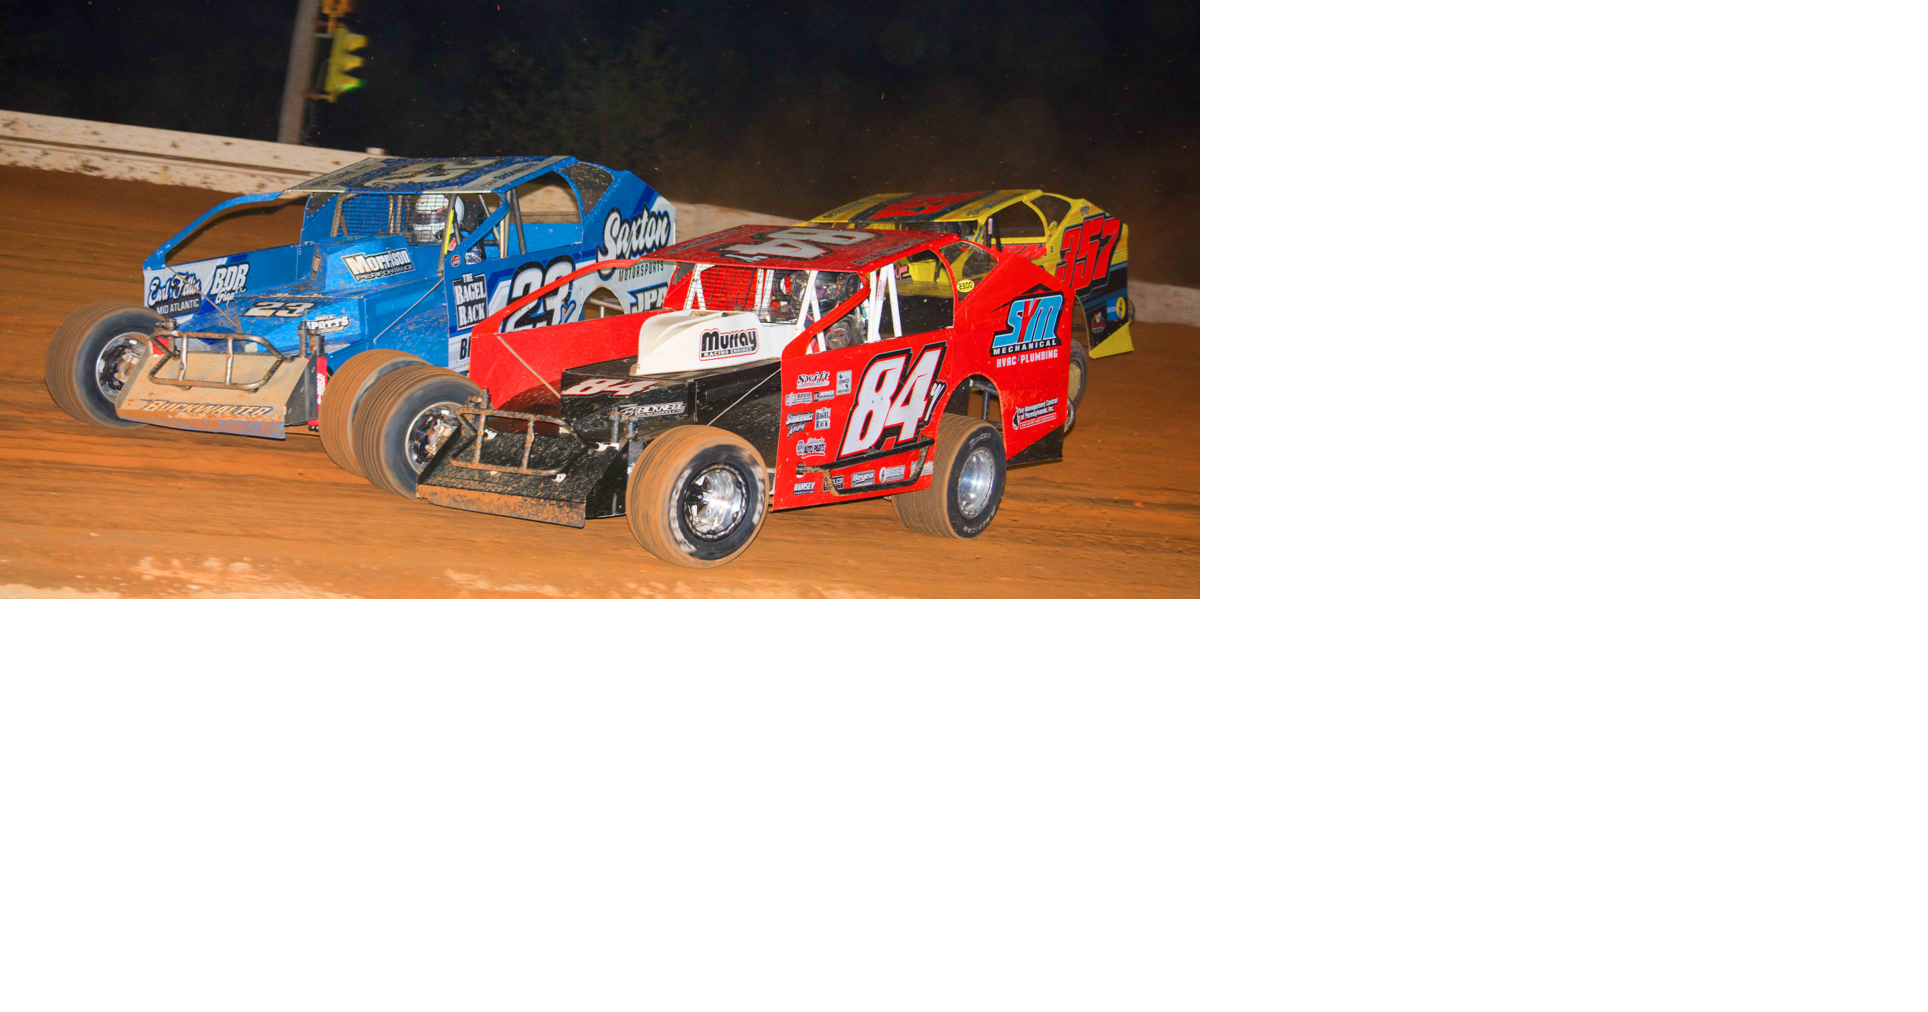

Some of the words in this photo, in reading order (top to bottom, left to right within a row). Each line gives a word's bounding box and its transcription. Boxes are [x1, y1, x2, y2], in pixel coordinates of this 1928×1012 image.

[598, 207, 669, 275] Saxton
[1055, 215, 1120, 290] 357
[348, 249, 411, 275] Morrison
[210, 263, 249, 295] BOB
[356, 265, 414, 281] PERFORMANCE
[462, 273, 473, 284] THE
[619, 261, 664, 281] MOTORSPORTS
[454, 282, 487, 305] BAGEL
[958, 281, 974, 290] 2300
[157, 302, 169, 315] MID
[170, 299, 200, 313] ATLANTIC
[245, 301, 314, 317] 23
[458, 303, 487, 327] RACK
[702, 330, 758, 352] Murray
[993, 339, 1057, 355] MECHANICAL
[997, 356, 1017, 368] HVAC
[1020, 349, 1058, 364] PLUMBING
[798, 371, 830, 384] Swift
[143, 401, 272, 416] BUCKWALTER
[794, 481, 815, 491] RAMSEY
